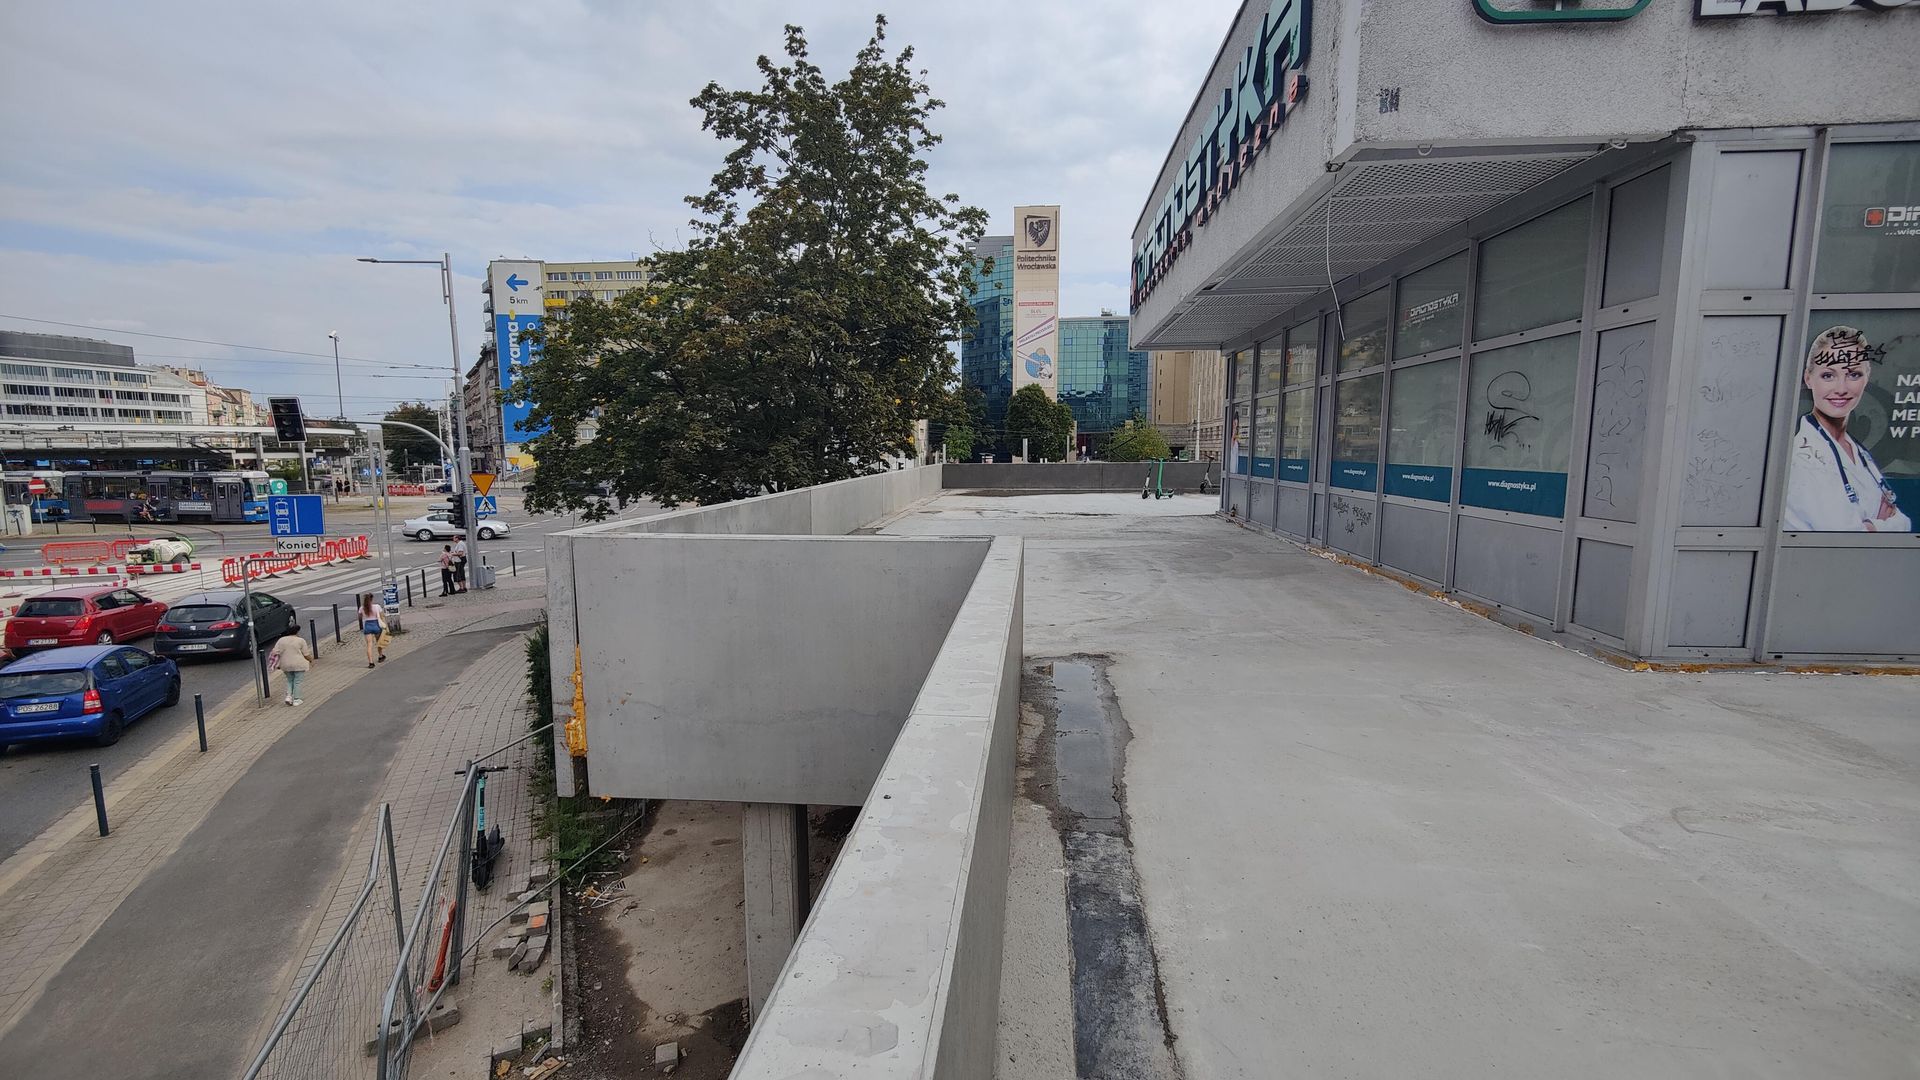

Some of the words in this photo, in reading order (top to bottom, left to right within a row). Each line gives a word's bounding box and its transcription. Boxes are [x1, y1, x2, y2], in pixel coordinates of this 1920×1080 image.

[1196, 75, 1306, 226] medyczne
[1016, 254, 1056, 262] Politechnika
[1016, 262, 1056, 270] Wrocławska
[509, 296, 516, 304] 5
[1410, 293, 1459, 317] DIAGNOSTYKA
[1890, 427, 1907, 438] W
[1487, 480, 1537, 492] www.diagnostyka.pl
[278, 541, 317, 549] Koniec
